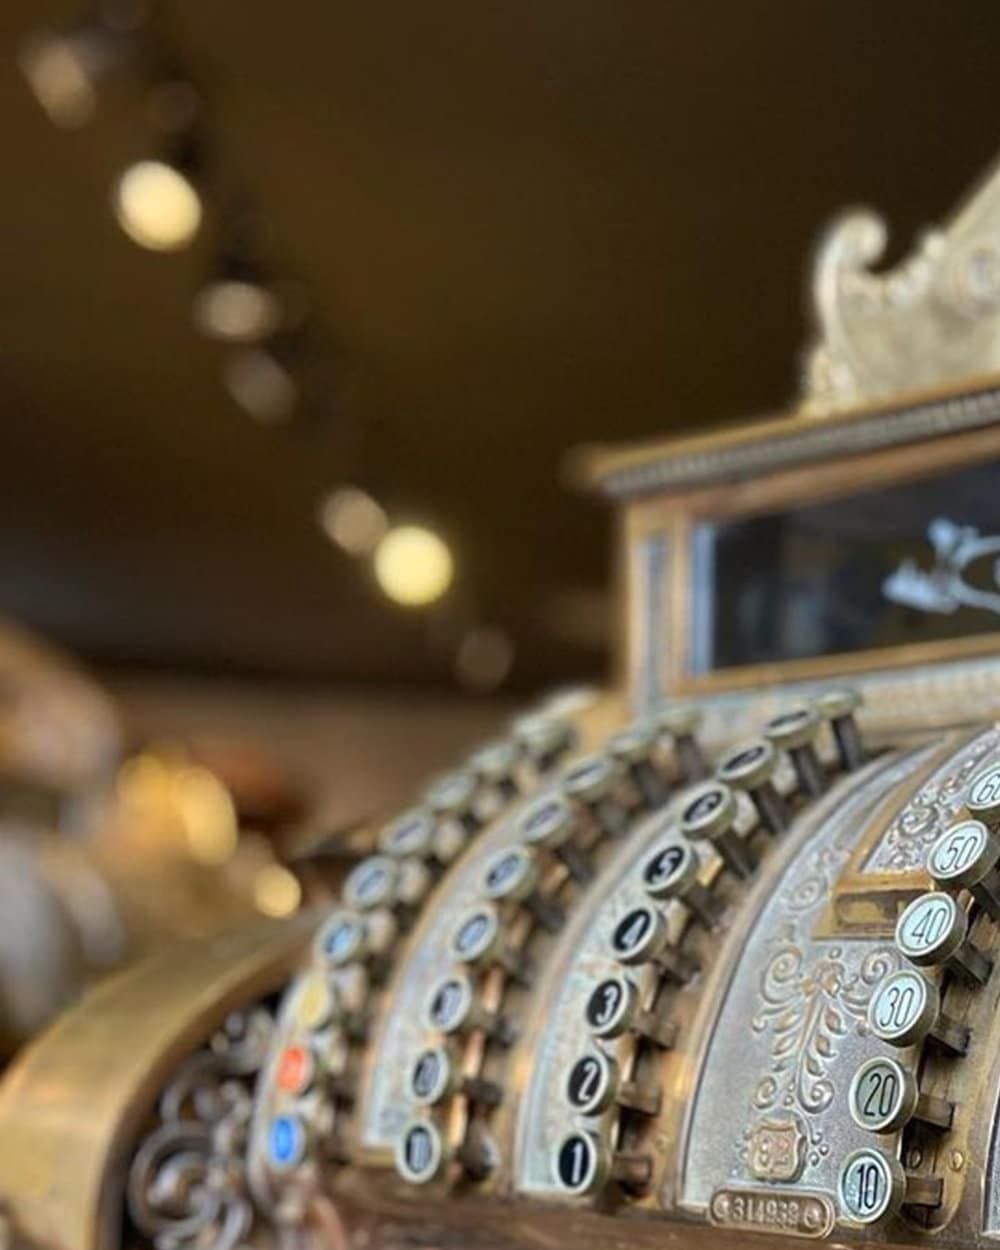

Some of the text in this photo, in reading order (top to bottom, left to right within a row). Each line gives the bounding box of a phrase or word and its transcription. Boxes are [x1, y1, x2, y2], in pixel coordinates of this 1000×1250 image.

[940, 836, 978, 871] 50
[911, 906, 947, 944] 40
[596, 985, 618, 1025] 3
[879, 986, 914, 1028] 30
[578, 1058, 599, 1100] 2
[864, 1072, 896, 1117] 20
[856, 1164, 878, 1210] 10
